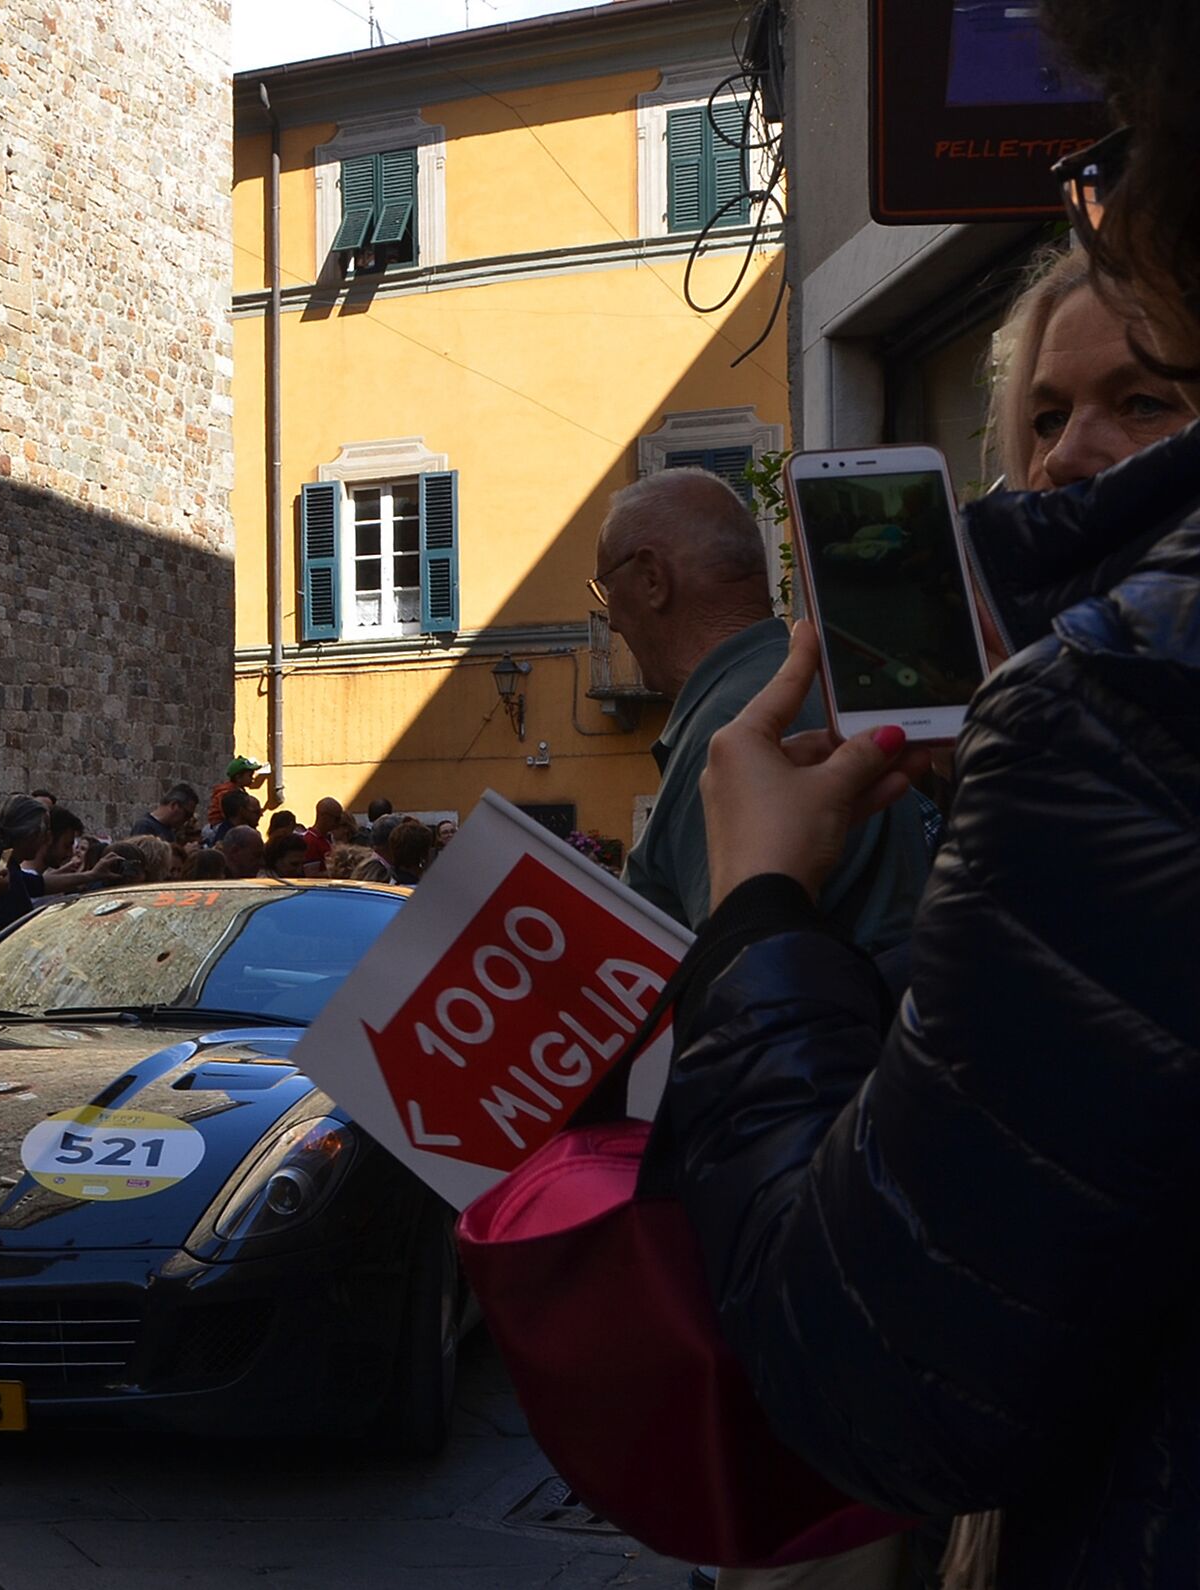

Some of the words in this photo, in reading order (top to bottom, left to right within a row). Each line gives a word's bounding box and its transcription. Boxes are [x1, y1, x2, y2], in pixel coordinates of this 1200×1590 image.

[152, 891, 221, 908] 521
[413, 905, 567, 1069] 1000
[479, 957, 667, 1151] MIGLIA
[55, 1131, 165, 1168] 521
